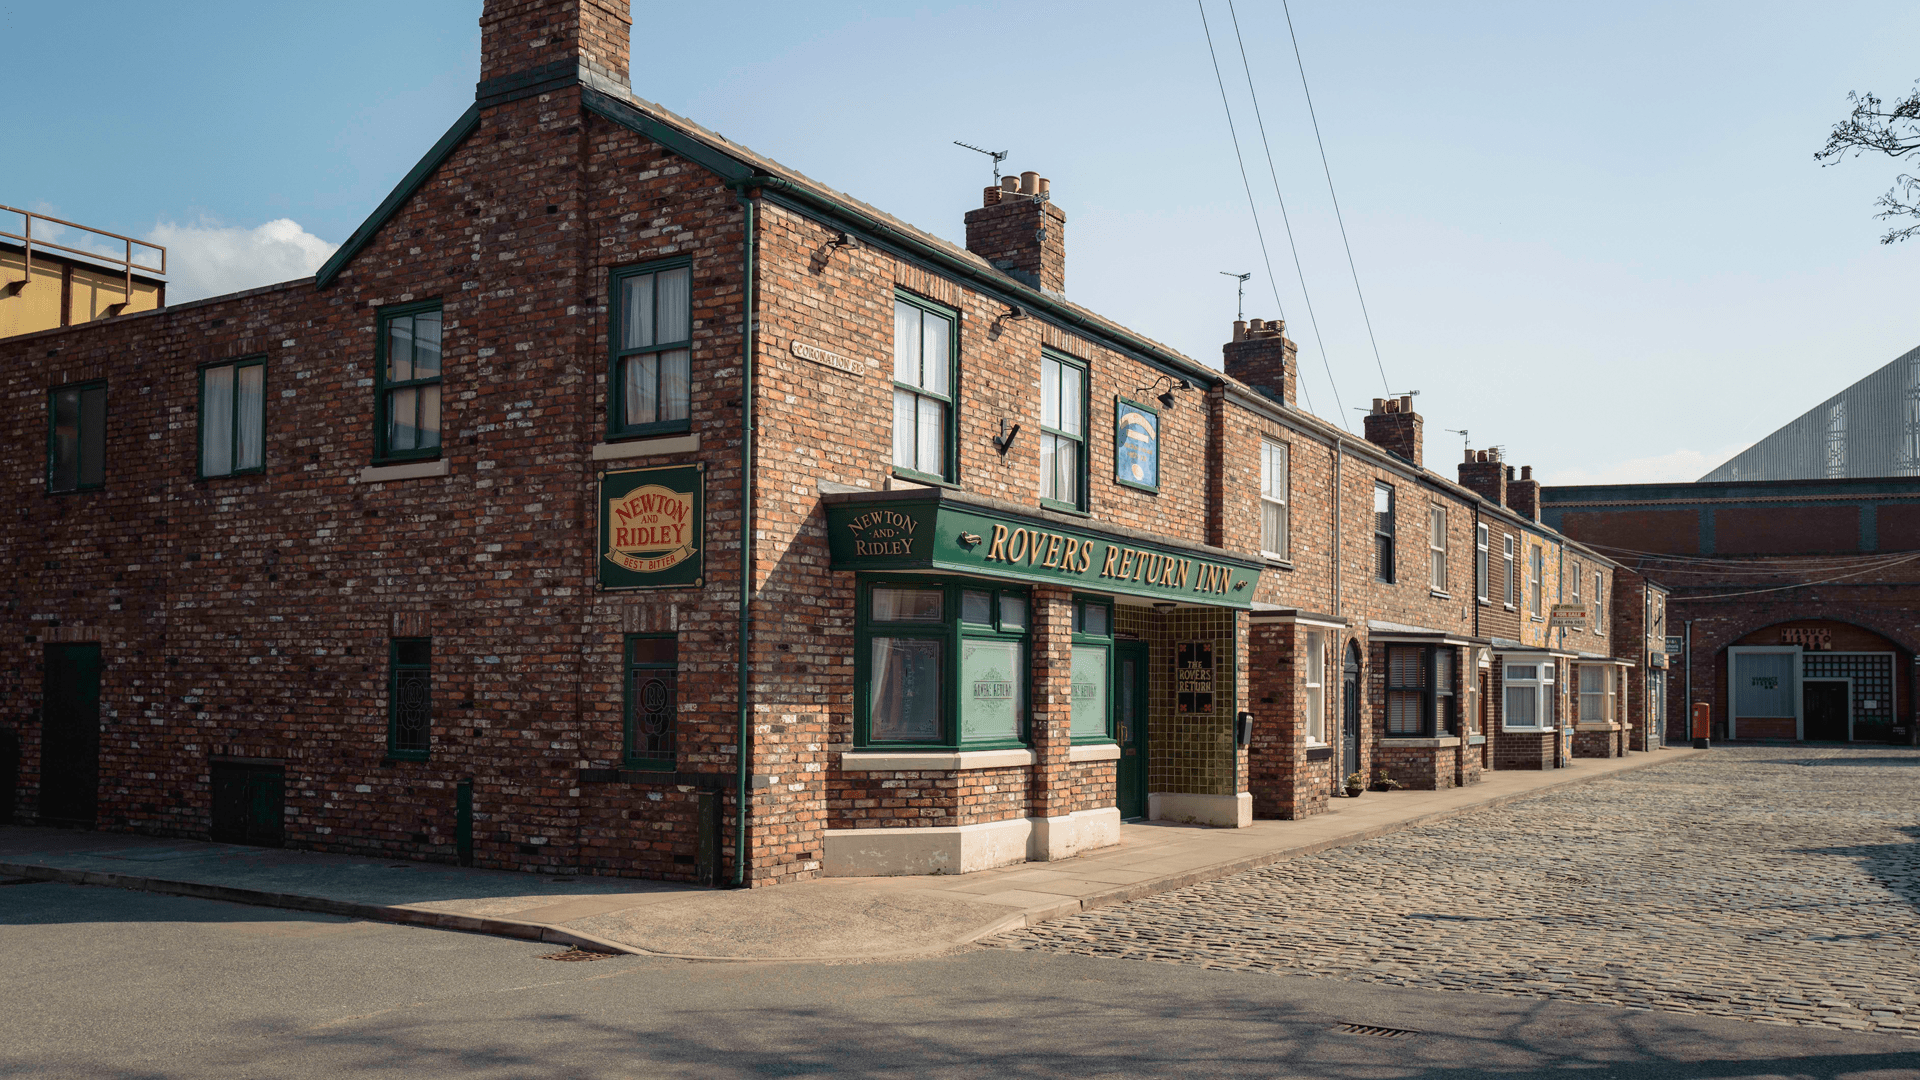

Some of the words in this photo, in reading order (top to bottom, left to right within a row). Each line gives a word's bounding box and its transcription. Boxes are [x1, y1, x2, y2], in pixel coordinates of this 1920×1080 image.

[796, 344, 850, 370] CORONATION
[615, 493, 690, 526] NEWTON
[641, 514, 659, 524] AND
[847, 510, 919, 537] NEWTON
[616, 523, 686, 548] RIDLEY
[873, 529, 895, 538] AND
[855, 538, 914, 556] RIDLEY
[623, 557, 644, 569] BEST
[648, 555, 677, 570] BITTER
[987, 523, 1095, 573] ROVERS
[1102, 544, 1192, 589] RETURN
[1195, 562, 1234, 595] INN
[1782, 635, 1831, 643] BISTRO
[1187, 660, 1202, 668] THE
[1179, 669, 1211, 680] ROVERS
[1179, 681, 1211, 692] RETURN
